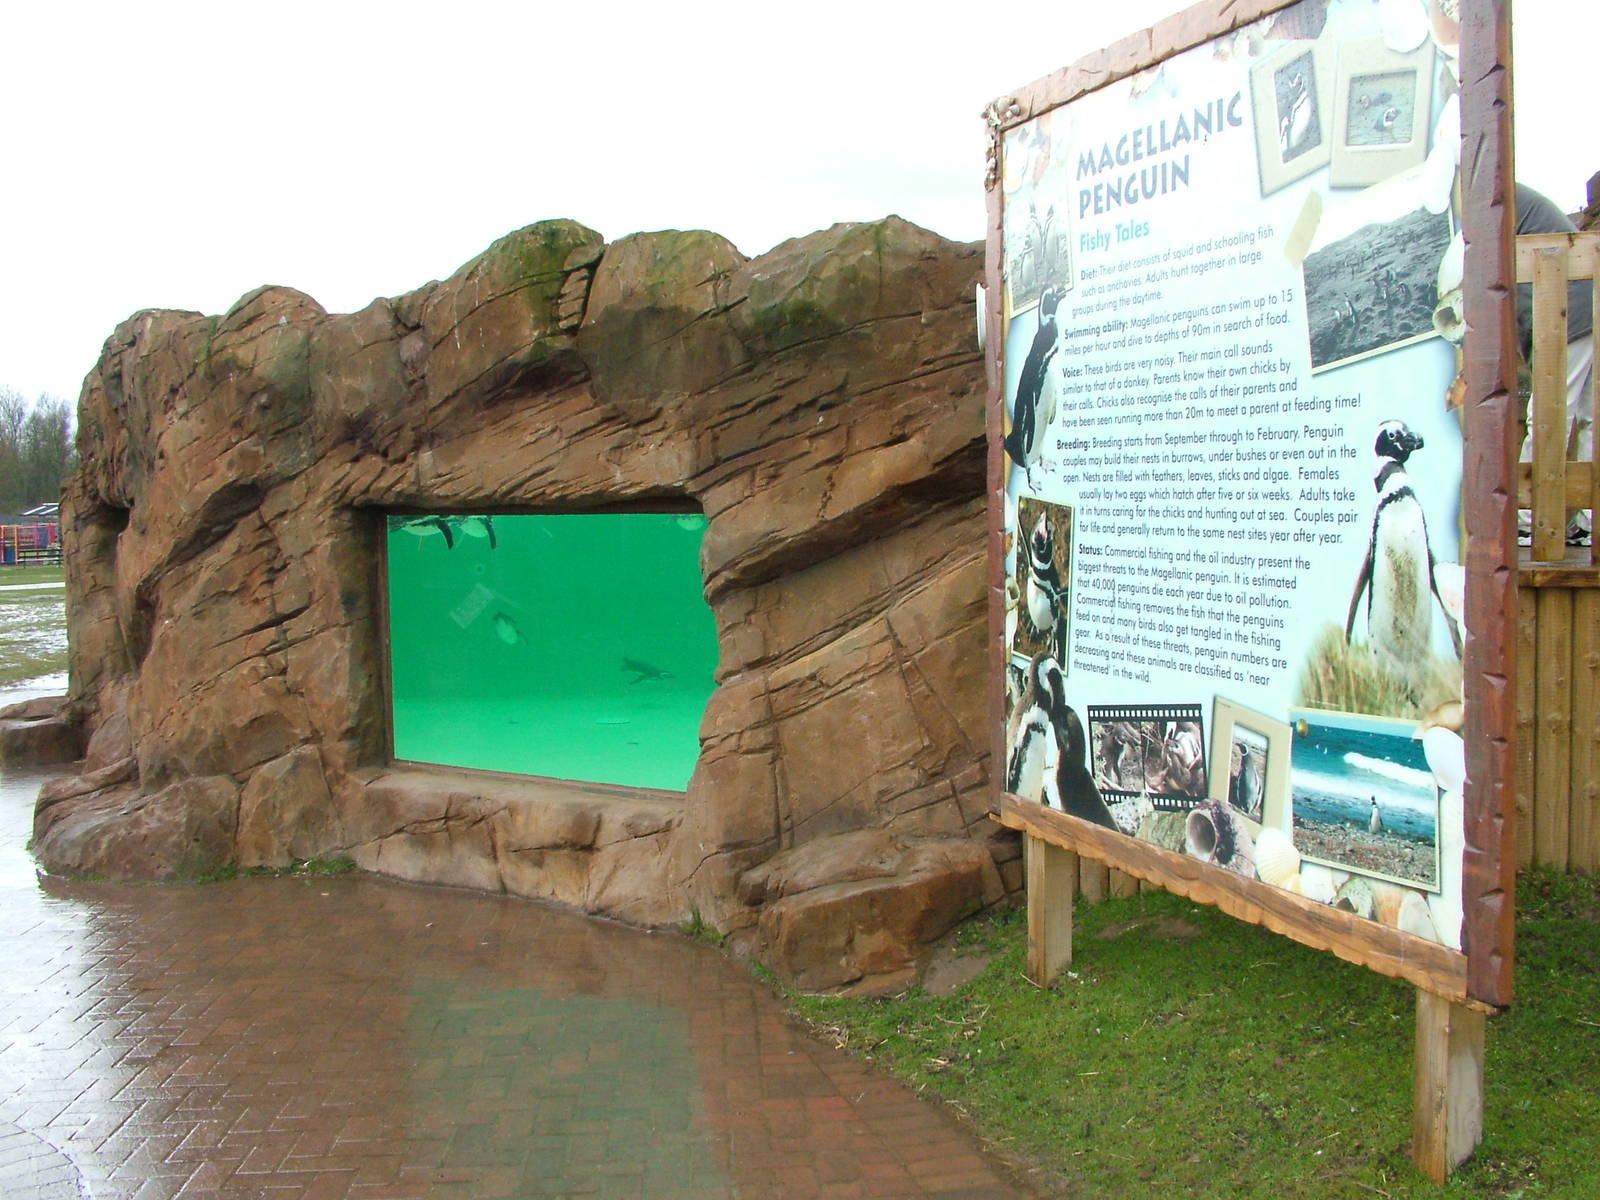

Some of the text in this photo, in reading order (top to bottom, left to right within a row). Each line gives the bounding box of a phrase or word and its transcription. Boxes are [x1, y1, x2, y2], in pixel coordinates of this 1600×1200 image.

[1076, 91, 1243, 181] MAGELLANIC
[1079, 154, 1190, 219] PENGUIN
[1080, 219, 1149, 252] Fishy Tales
[1134, 255, 1160, 268] consists
[1173, 244, 1193, 260] squid
[1214, 232, 1255, 249] schooling
[1258, 225, 1274, 238] fish
[1146, 251, 1261, 282] Adults hunt together large
[1065, 325, 1100, 339] Swimming
[1130, 313, 1170, 329] Magellanic
[1173, 307, 1209, 323] penguins
[1211, 304, 1226, 315] can
[1229, 298, 1251, 311] swim
[1254, 298, 1265, 310] up
[1282, 289, 1292, 302] 15
[1065, 309, 1290, 355] miles hour dive depths 90m search food.
[1085, 364, 1103, 375] These
[1105, 361, 1121, 373] birds
[1138, 359, 1152, 369] very
[1155, 354, 1175, 367] noisy.
[1178, 351, 1198, 363] Their
[1201, 347, 1221, 360] main
[1224, 344, 1238, 358] call
[1242, 339, 1272, 356] sounds
[1063, 358, 1291, 395] similar that Parents know their own chicks by
[1062, 393, 1360, 428] have running more than 20m meet parent feeding time!
[1063, 378, 1297, 411] their Chicks also recognise calls their parents and
[1092, 436, 1121, 449] Breeding
[1124, 438, 1142, 446] starts
[1145, 434, 1162, 445] from
[1165, 431, 1207, 447] September
[1210, 429, 1242, 445] through
[1258, 427, 1300, 442] February.
[1304, 424, 1343, 441] Penguin
[1063, 447, 1324, 468] couples their nests under bushes even out
[1083, 472, 1100, 481] Nests
[1116, 470, 1132, 482] filled
[1135, 472, 1149, 481] with
[1218, 468, 1240, 480] sticks
[1243, 468, 1260, 480] and
[1299, 466, 1339, 480] Females
[1079, 488, 1101, 499] usually
[1115, 490, 1128, 499] two
[1130, 491, 1146, 502] eggs
[1149, 488, 1170, 499] which
[1173, 488, 1194, 499] hatch
[1197, 487, 1215, 500] after
[1218, 487, 1232, 500] five
[1299, 486, 1329, 501] Adults
[1334, 486, 1355, 501] take
[1112, 506, 1358, 525] caring chicks hunting out sea. Couples pair
[1118, 523, 1342, 546] generally return same nest sites year after year.
[1105, 545, 1146, 558] Commercial
[1149, 547, 1173, 563] fishing
[1222, 552, 1255, 568] industry
[1258, 556, 1292, 569] present
[1078, 560, 1296, 589] biggest threats Magellanic penguin. estimated
[1092, 579, 1292, 609] 40,000 penguins die each year due pollution.
[1077, 593, 1284, 629] Commercial fishing removes fish that penguins
[1112, 632, 1269, 666] result these threats, penguin numbers
[1117, 618, 1280, 651] many birds also get tangled fishing
[1075, 641, 1231, 679] decreasing these animals classified
[1135, 670, 1151, 683] wild.
